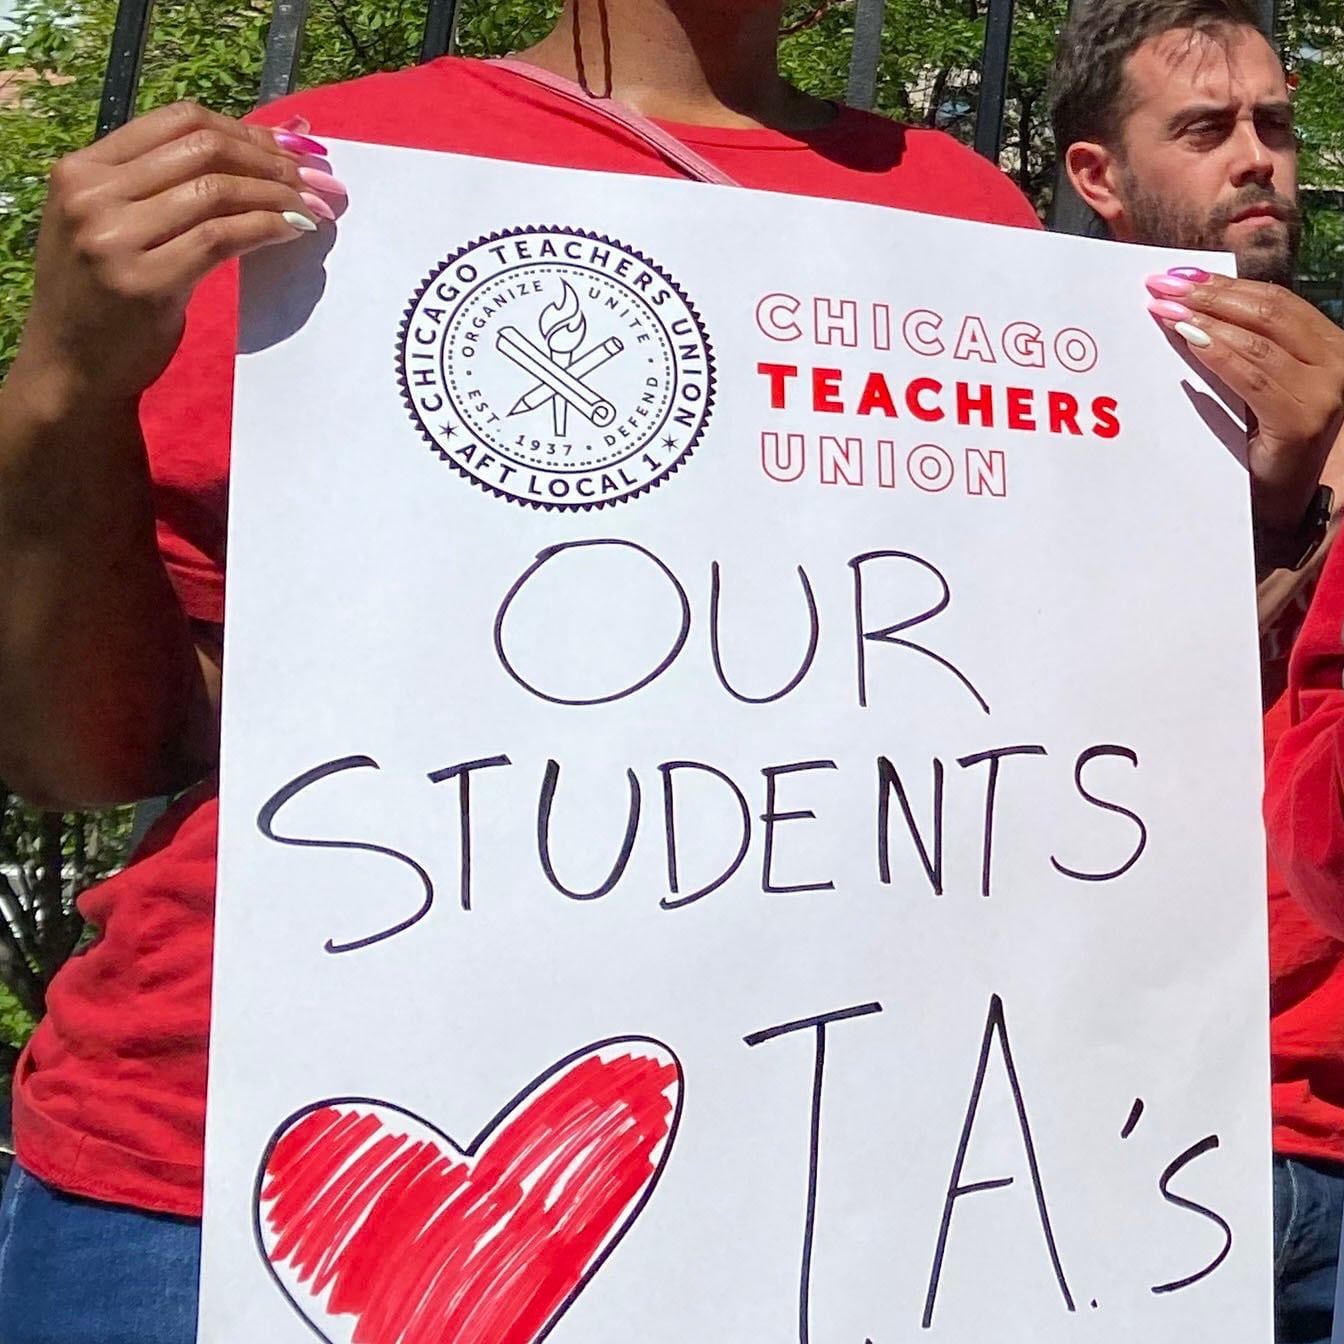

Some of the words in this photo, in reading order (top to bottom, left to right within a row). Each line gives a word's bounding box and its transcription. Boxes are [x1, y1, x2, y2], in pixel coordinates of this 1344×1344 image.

[413, 263, 477, 412] CHICAGO
[489, 239, 671, 307] TEACHERS
[671, 318, 702, 427] UNION
[756, 293, 1098, 373] CHICAGO
[756, 362, 1121, 440] TEACHERS
[455, 443, 517, 484] AFT
[528, 467, 638, 497] LOCAL
[642, 453, 662, 473] 1
[760, 432, 1008, 498] UNION
[493, 536, 991, 715] OUR
[256, 743, 1148, 953] STUDENTS
